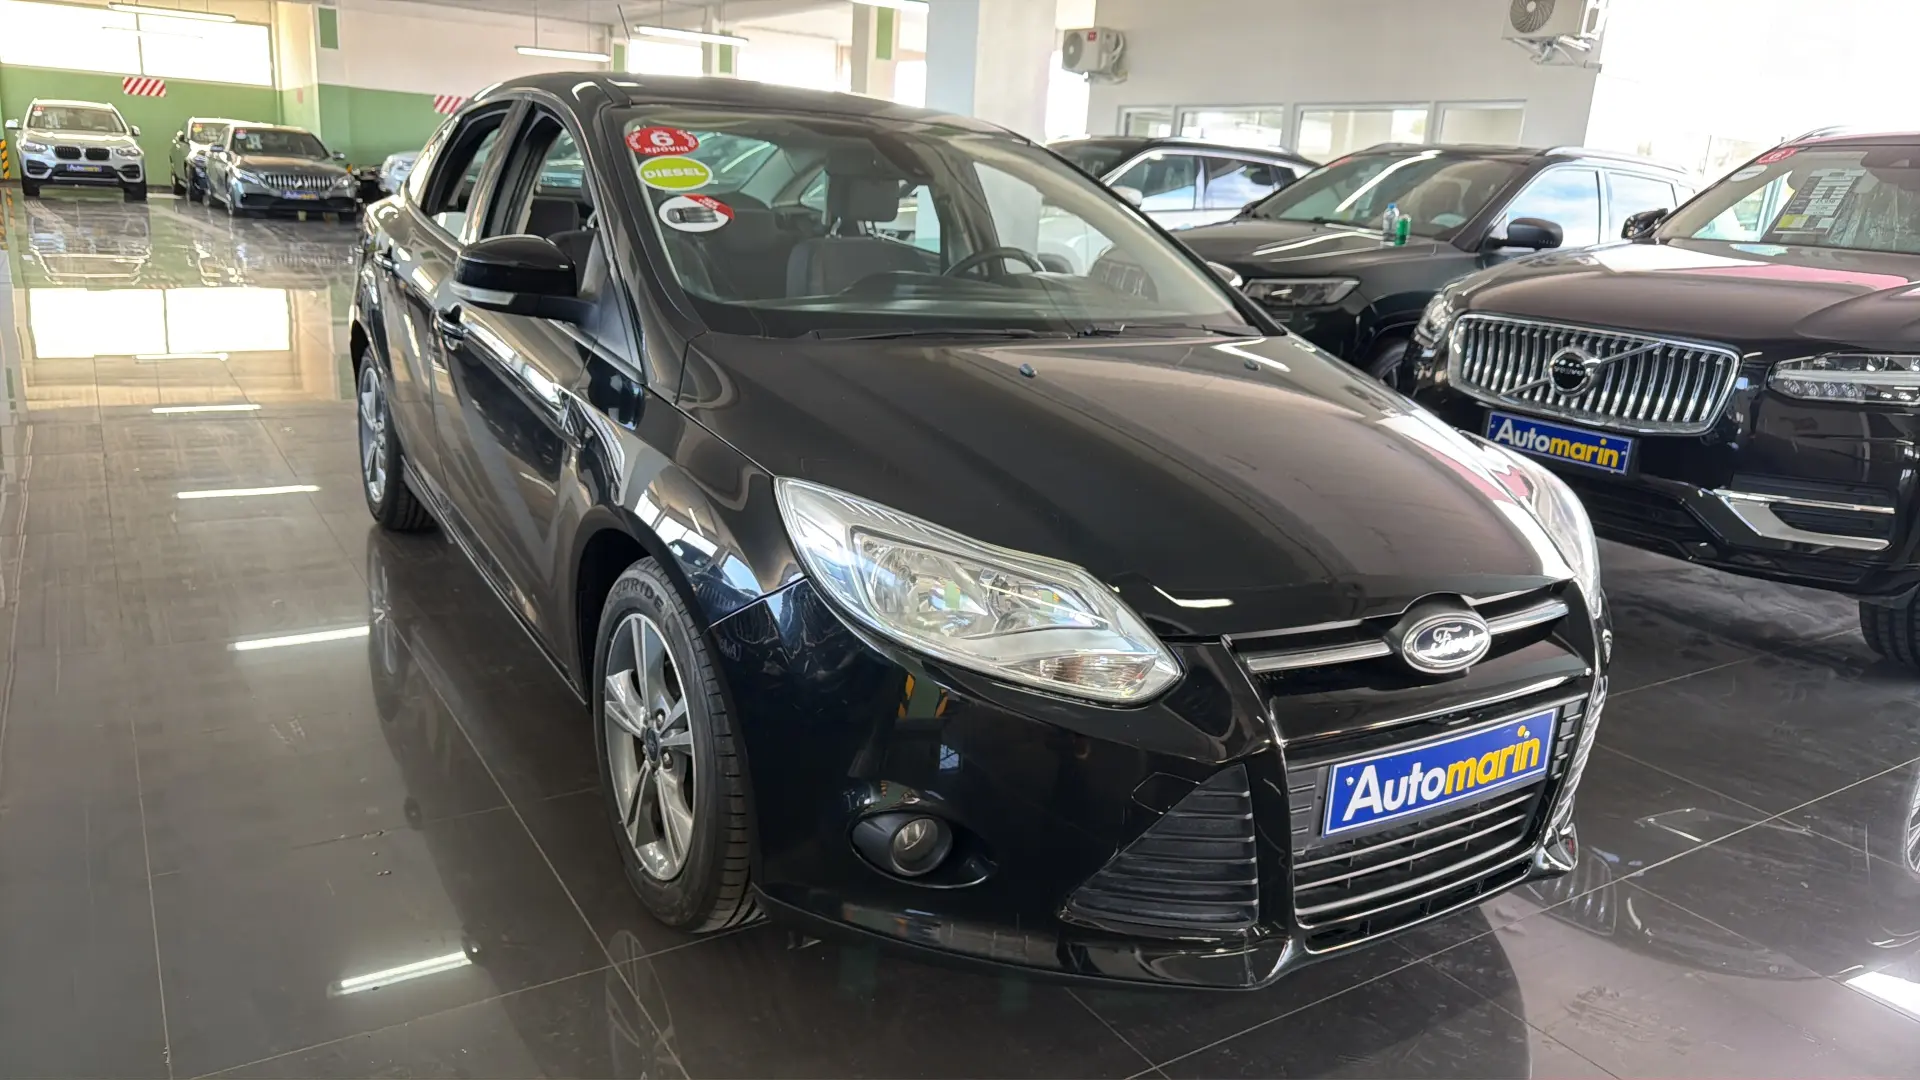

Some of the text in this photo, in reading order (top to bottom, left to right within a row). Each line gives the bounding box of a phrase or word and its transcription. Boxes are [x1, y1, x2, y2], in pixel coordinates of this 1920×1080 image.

[650, 130, 674, 146] 6
[644, 167, 706, 179] DIESEL
[1494, 418, 1619, 467] Automarin
[1417, 624, 1485, 657] Ford
[1342, 724, 1541, 822] Automarin
